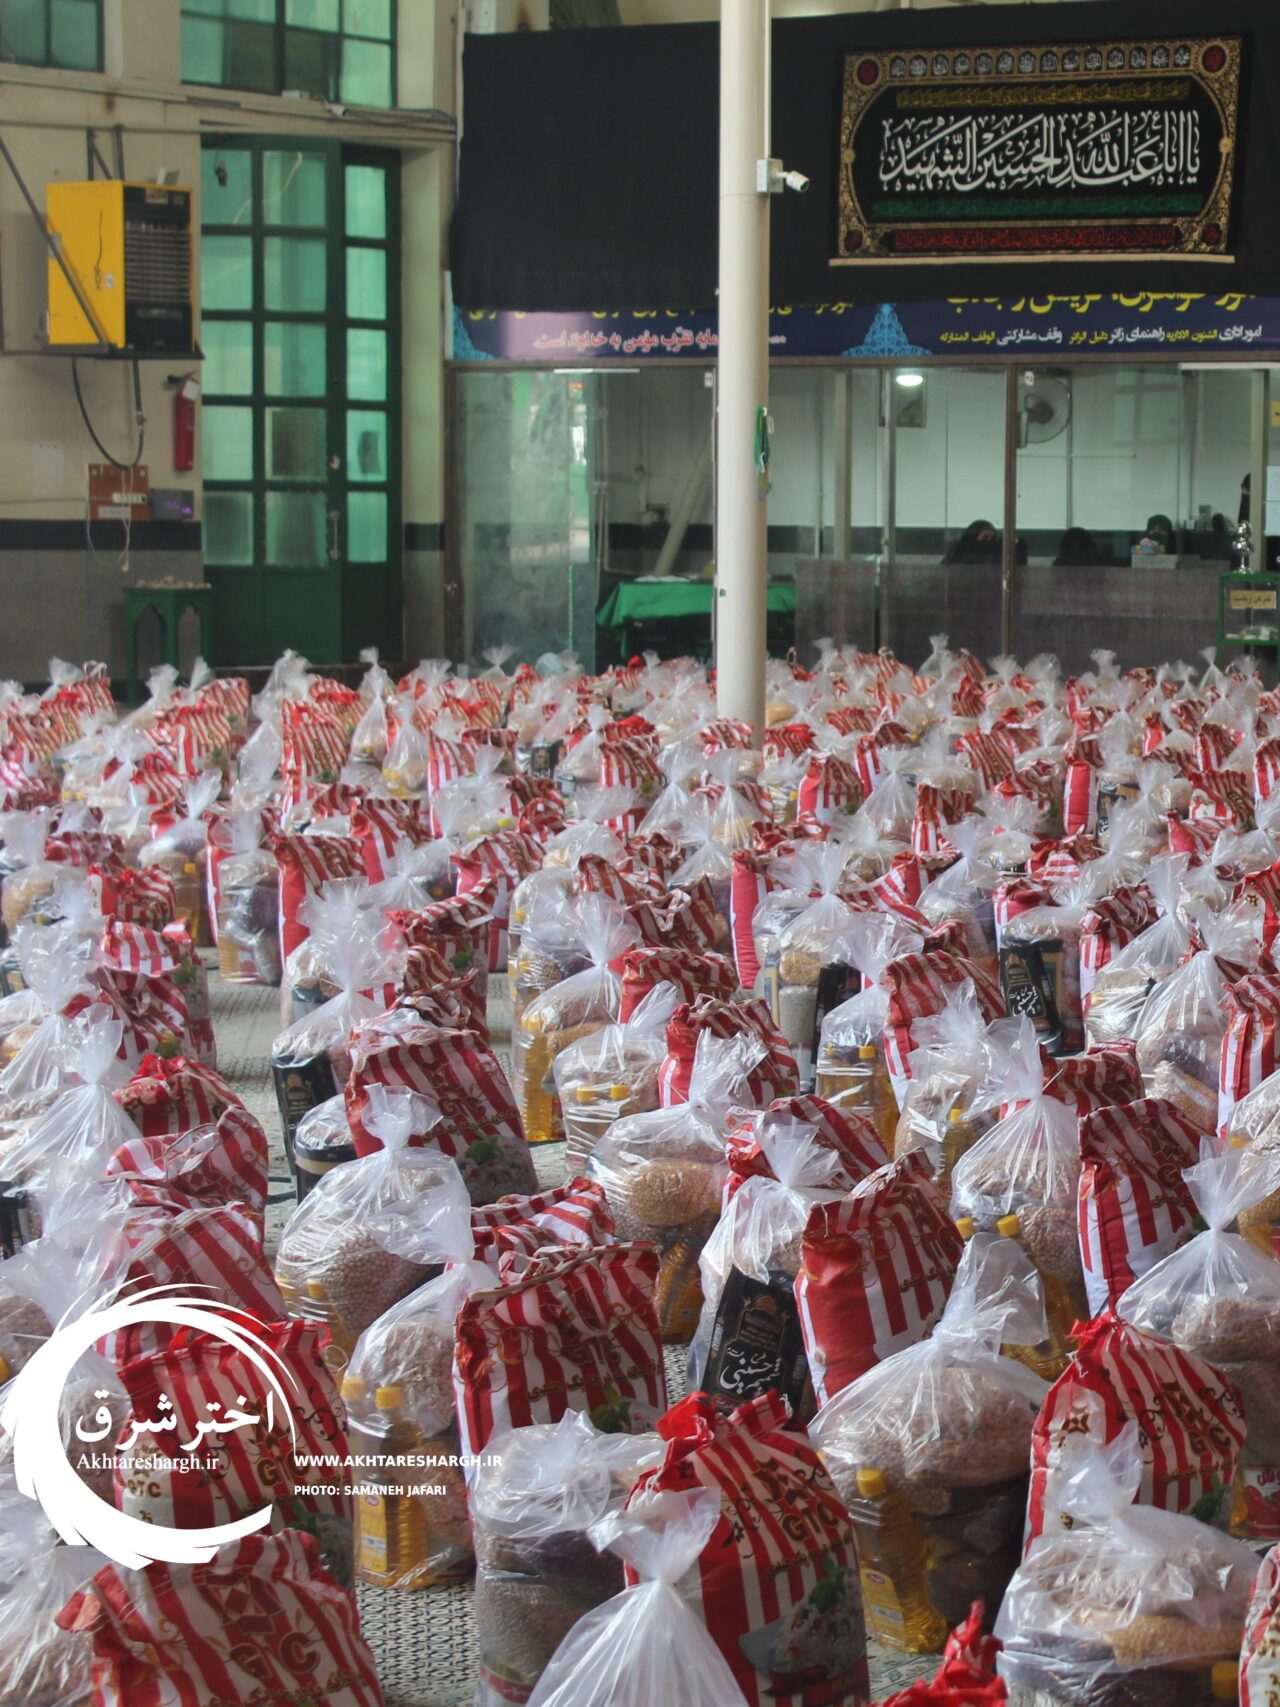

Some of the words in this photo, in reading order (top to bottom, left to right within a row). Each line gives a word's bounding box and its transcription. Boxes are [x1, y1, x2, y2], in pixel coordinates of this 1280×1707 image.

[609, 332, 623, 350] به
[996, 327, 1038, 346] مشارکتی
[1038, 326, 1064, 344] وقف
[1125, 326, 1165, 342] راهنمای
[1219, 324, 1244, 342] اداری
[1244, 324, 1263, 342] امور
[781, 1501, 840, 1541] GTC
